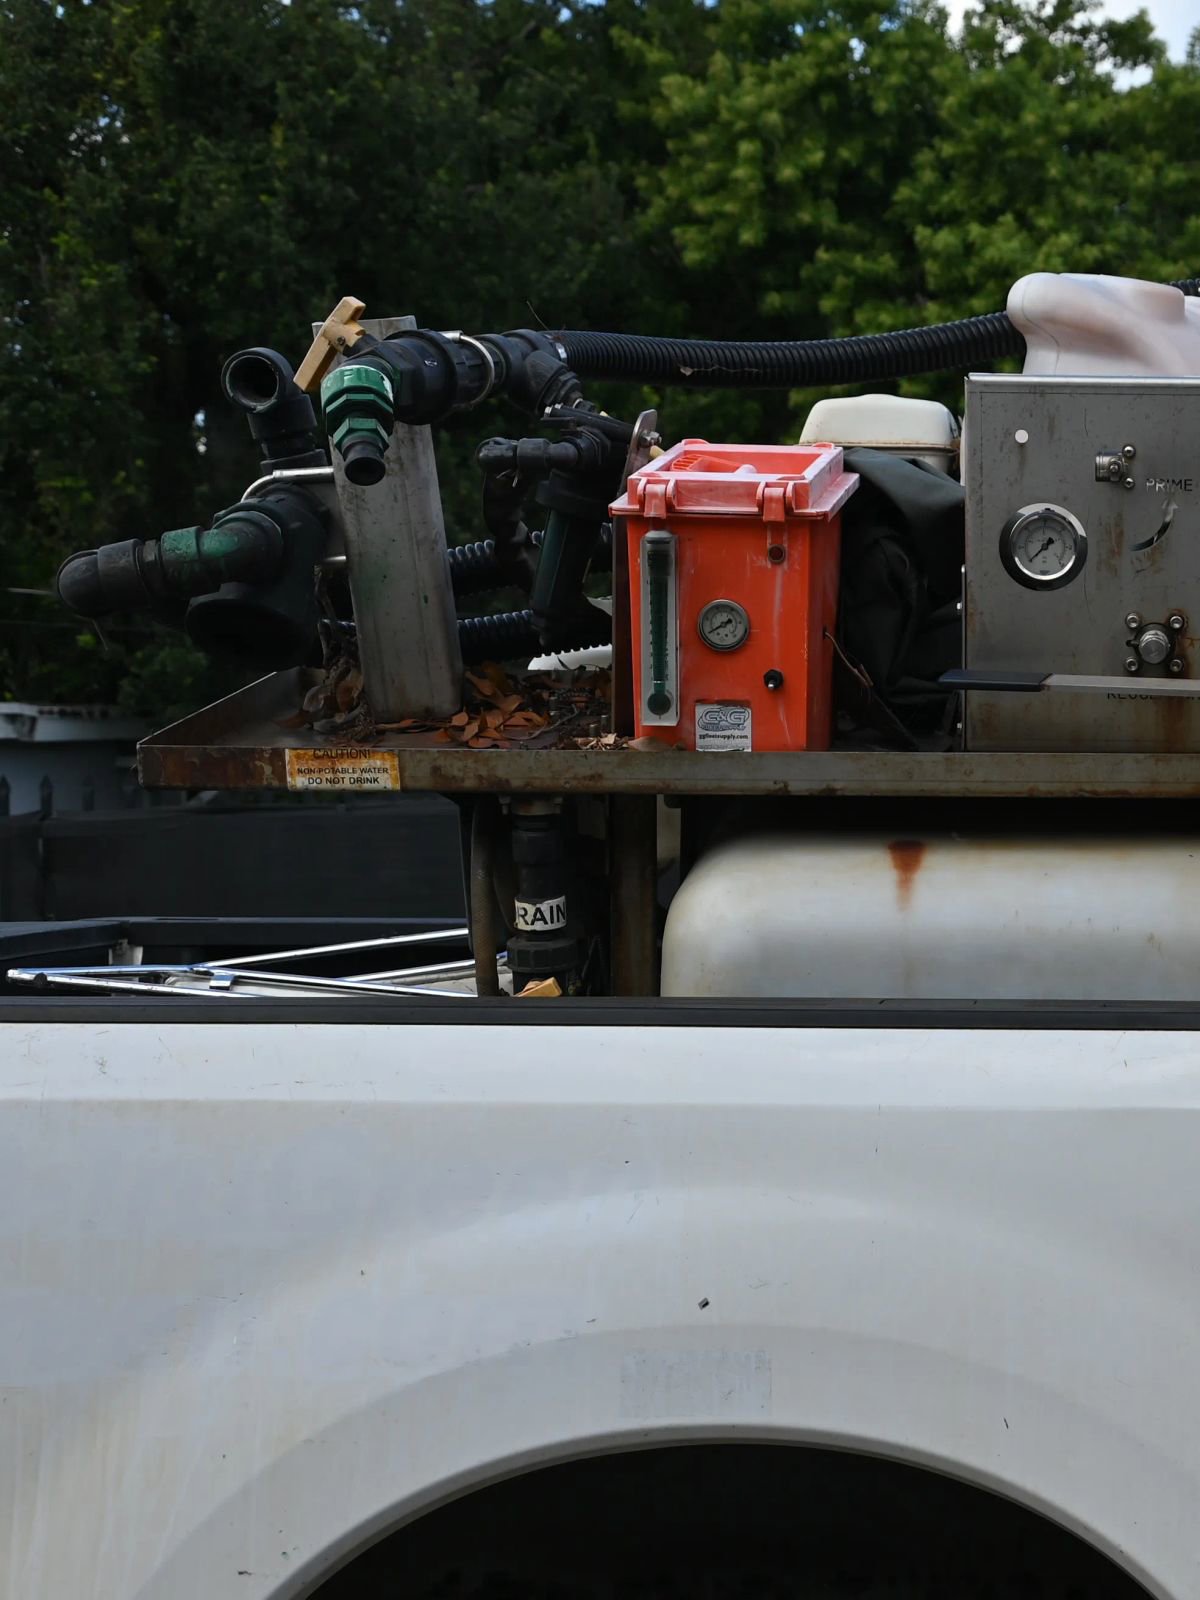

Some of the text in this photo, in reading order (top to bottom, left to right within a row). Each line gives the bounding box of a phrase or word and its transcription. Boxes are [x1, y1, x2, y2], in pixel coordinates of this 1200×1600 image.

[1146, 478, 1193, 492] PRIME
[313, 748, 370, 759] CAUTION!
[297, 767, 357, 775] NON-POTABLE
[307, 776, 380, 785] DO NOT DRINK
